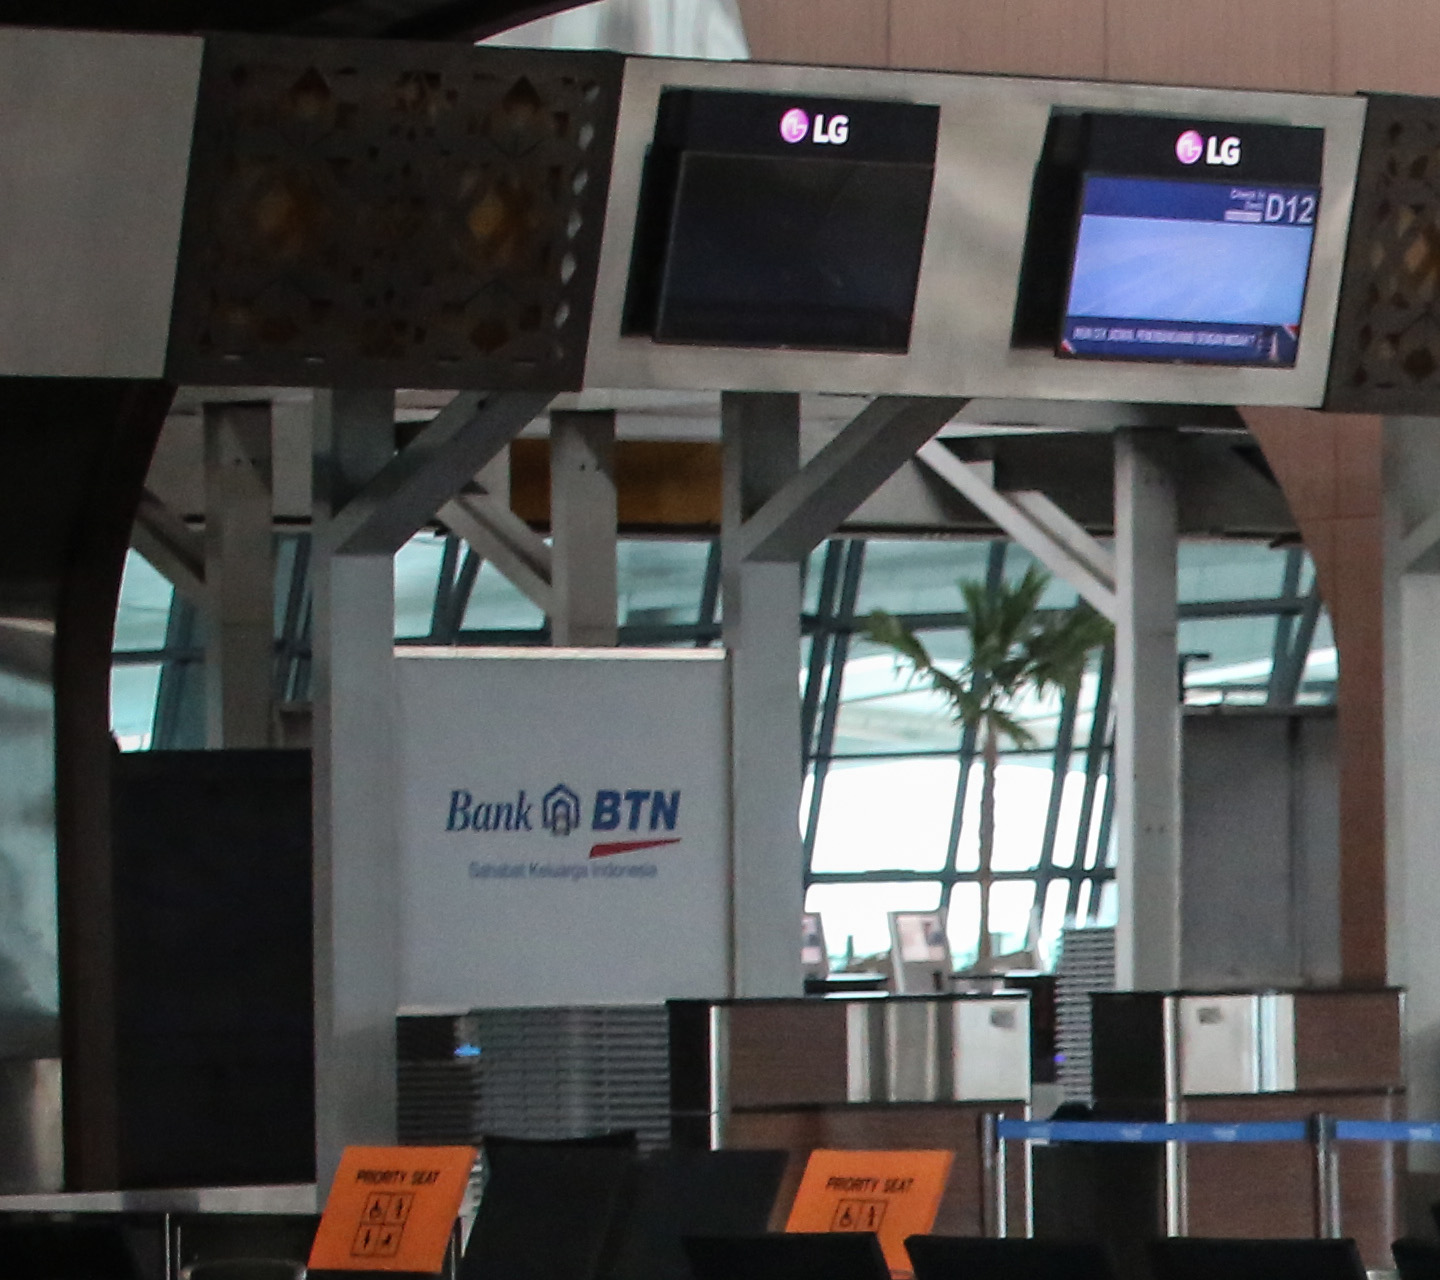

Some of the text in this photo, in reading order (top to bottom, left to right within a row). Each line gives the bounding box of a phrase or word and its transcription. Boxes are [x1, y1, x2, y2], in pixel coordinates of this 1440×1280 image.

[813, 115, 848, 144] LG
[1206, 137, 1240, 165] LG
[1264, 192, 1316, 224] D12
[445, 789, 681, 832] Bank BTN
[355, 1169, 441, 1186] PRIORITY SEAT
[825, 1176, 914, 1194] PRIORITY SEAT
